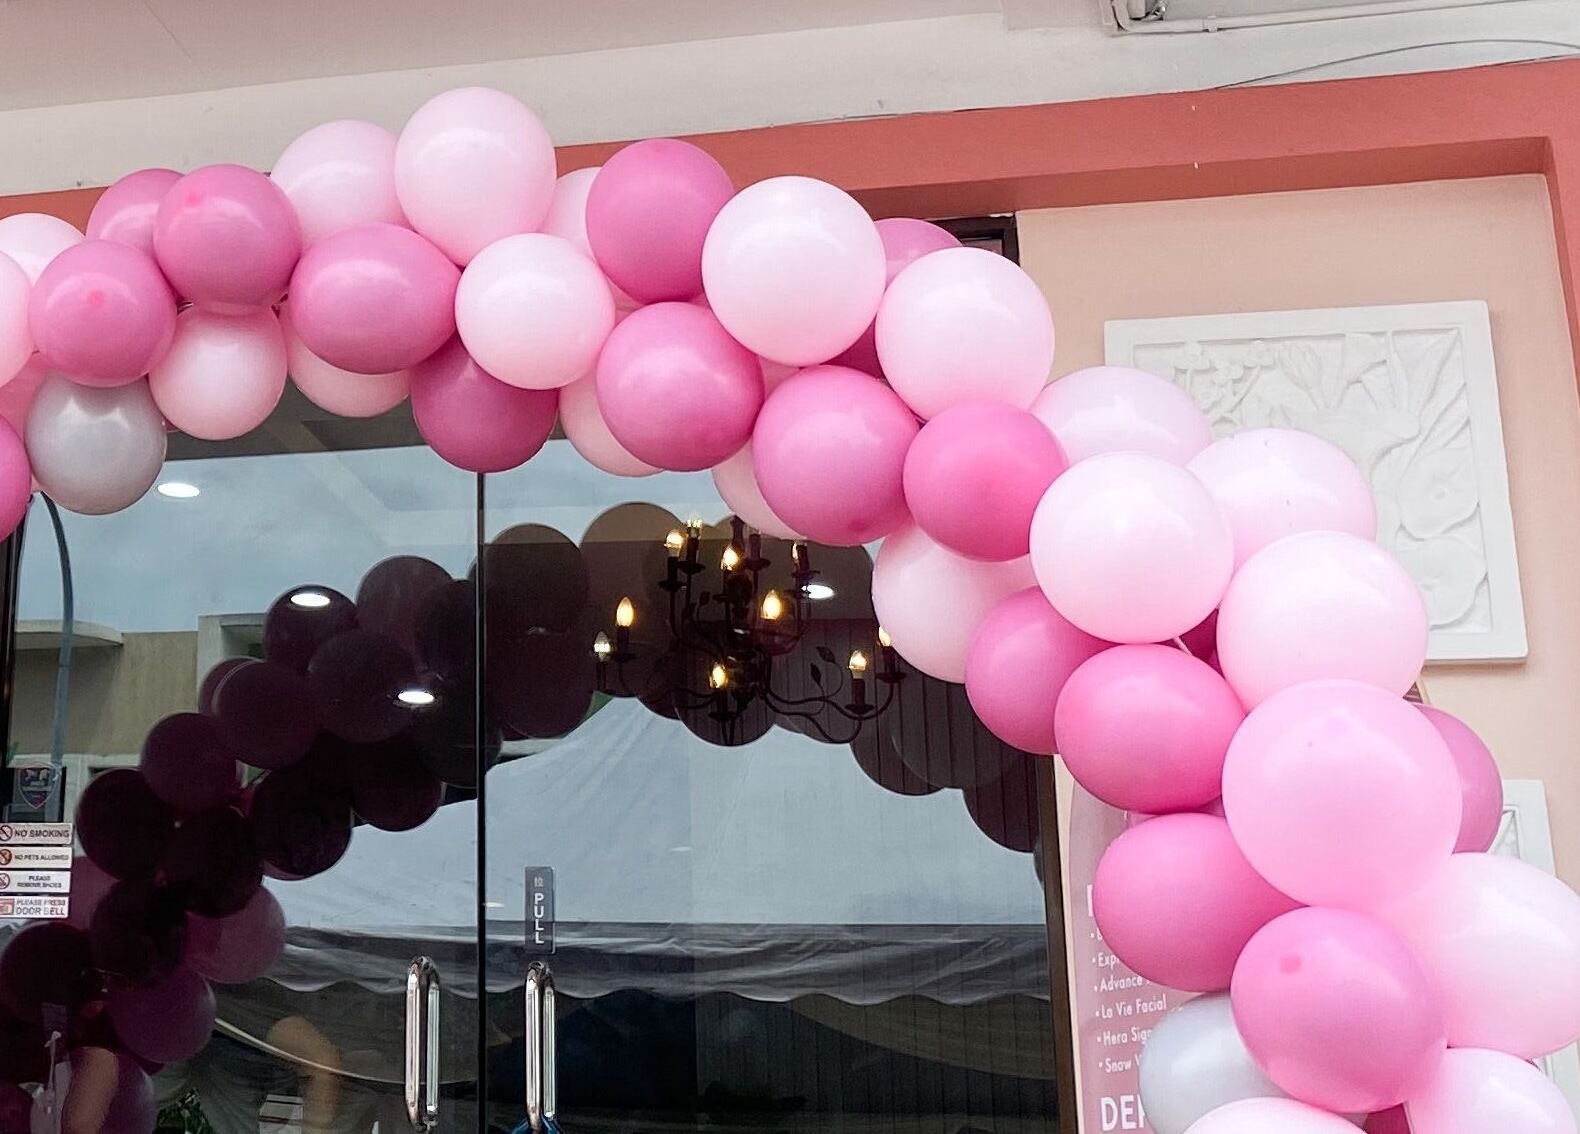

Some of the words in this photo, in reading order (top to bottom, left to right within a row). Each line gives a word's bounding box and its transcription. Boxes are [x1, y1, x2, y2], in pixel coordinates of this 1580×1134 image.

[14, 829, 27, 837] NO
[29, 829, 70, 837] SMOKING
[15, 907, 41, 915] DOOR
[43, 907, 66, 915] BELL
[534, 892, 544, 944] PULL
[1100, 975, 1143, 993] Advance
[1101, 1004, 1113, 1018] La
[1116, 1001, 1133, 1016] Vie
[1136, 993, 1166, 1013] Facial
[1103, 1030, 1128, 1046] Hera
[1105, 1058, 1132, 1073] Snow
